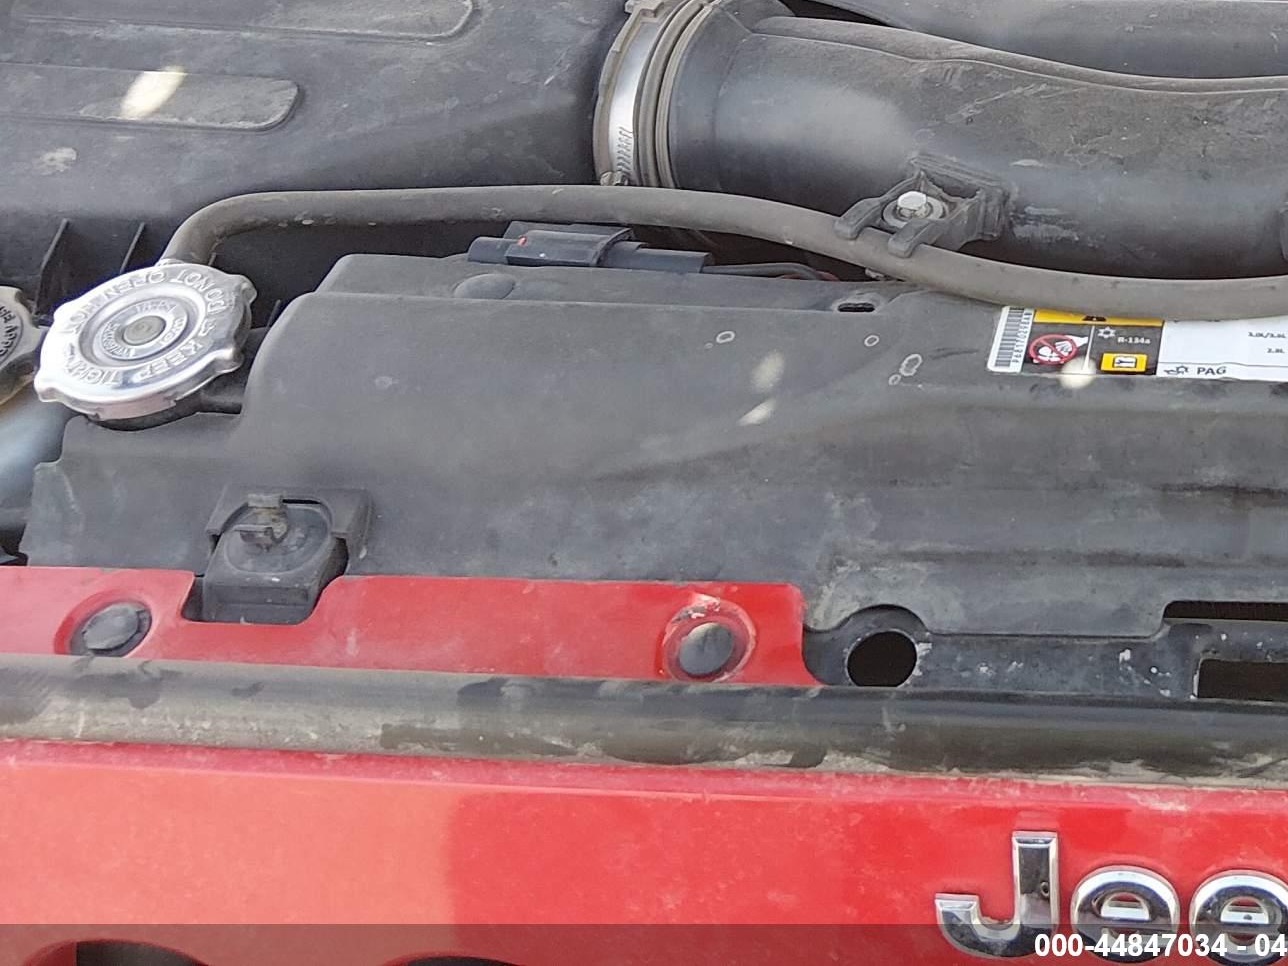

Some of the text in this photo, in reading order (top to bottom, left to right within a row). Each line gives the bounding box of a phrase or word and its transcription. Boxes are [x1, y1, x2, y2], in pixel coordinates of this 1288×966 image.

[104, 270, 165, 299] OPEN
[171, 269, 212, 293] NOT
[137, 338, 203, 380] KEEP
[1196, 365, 1227, 377] PAG
